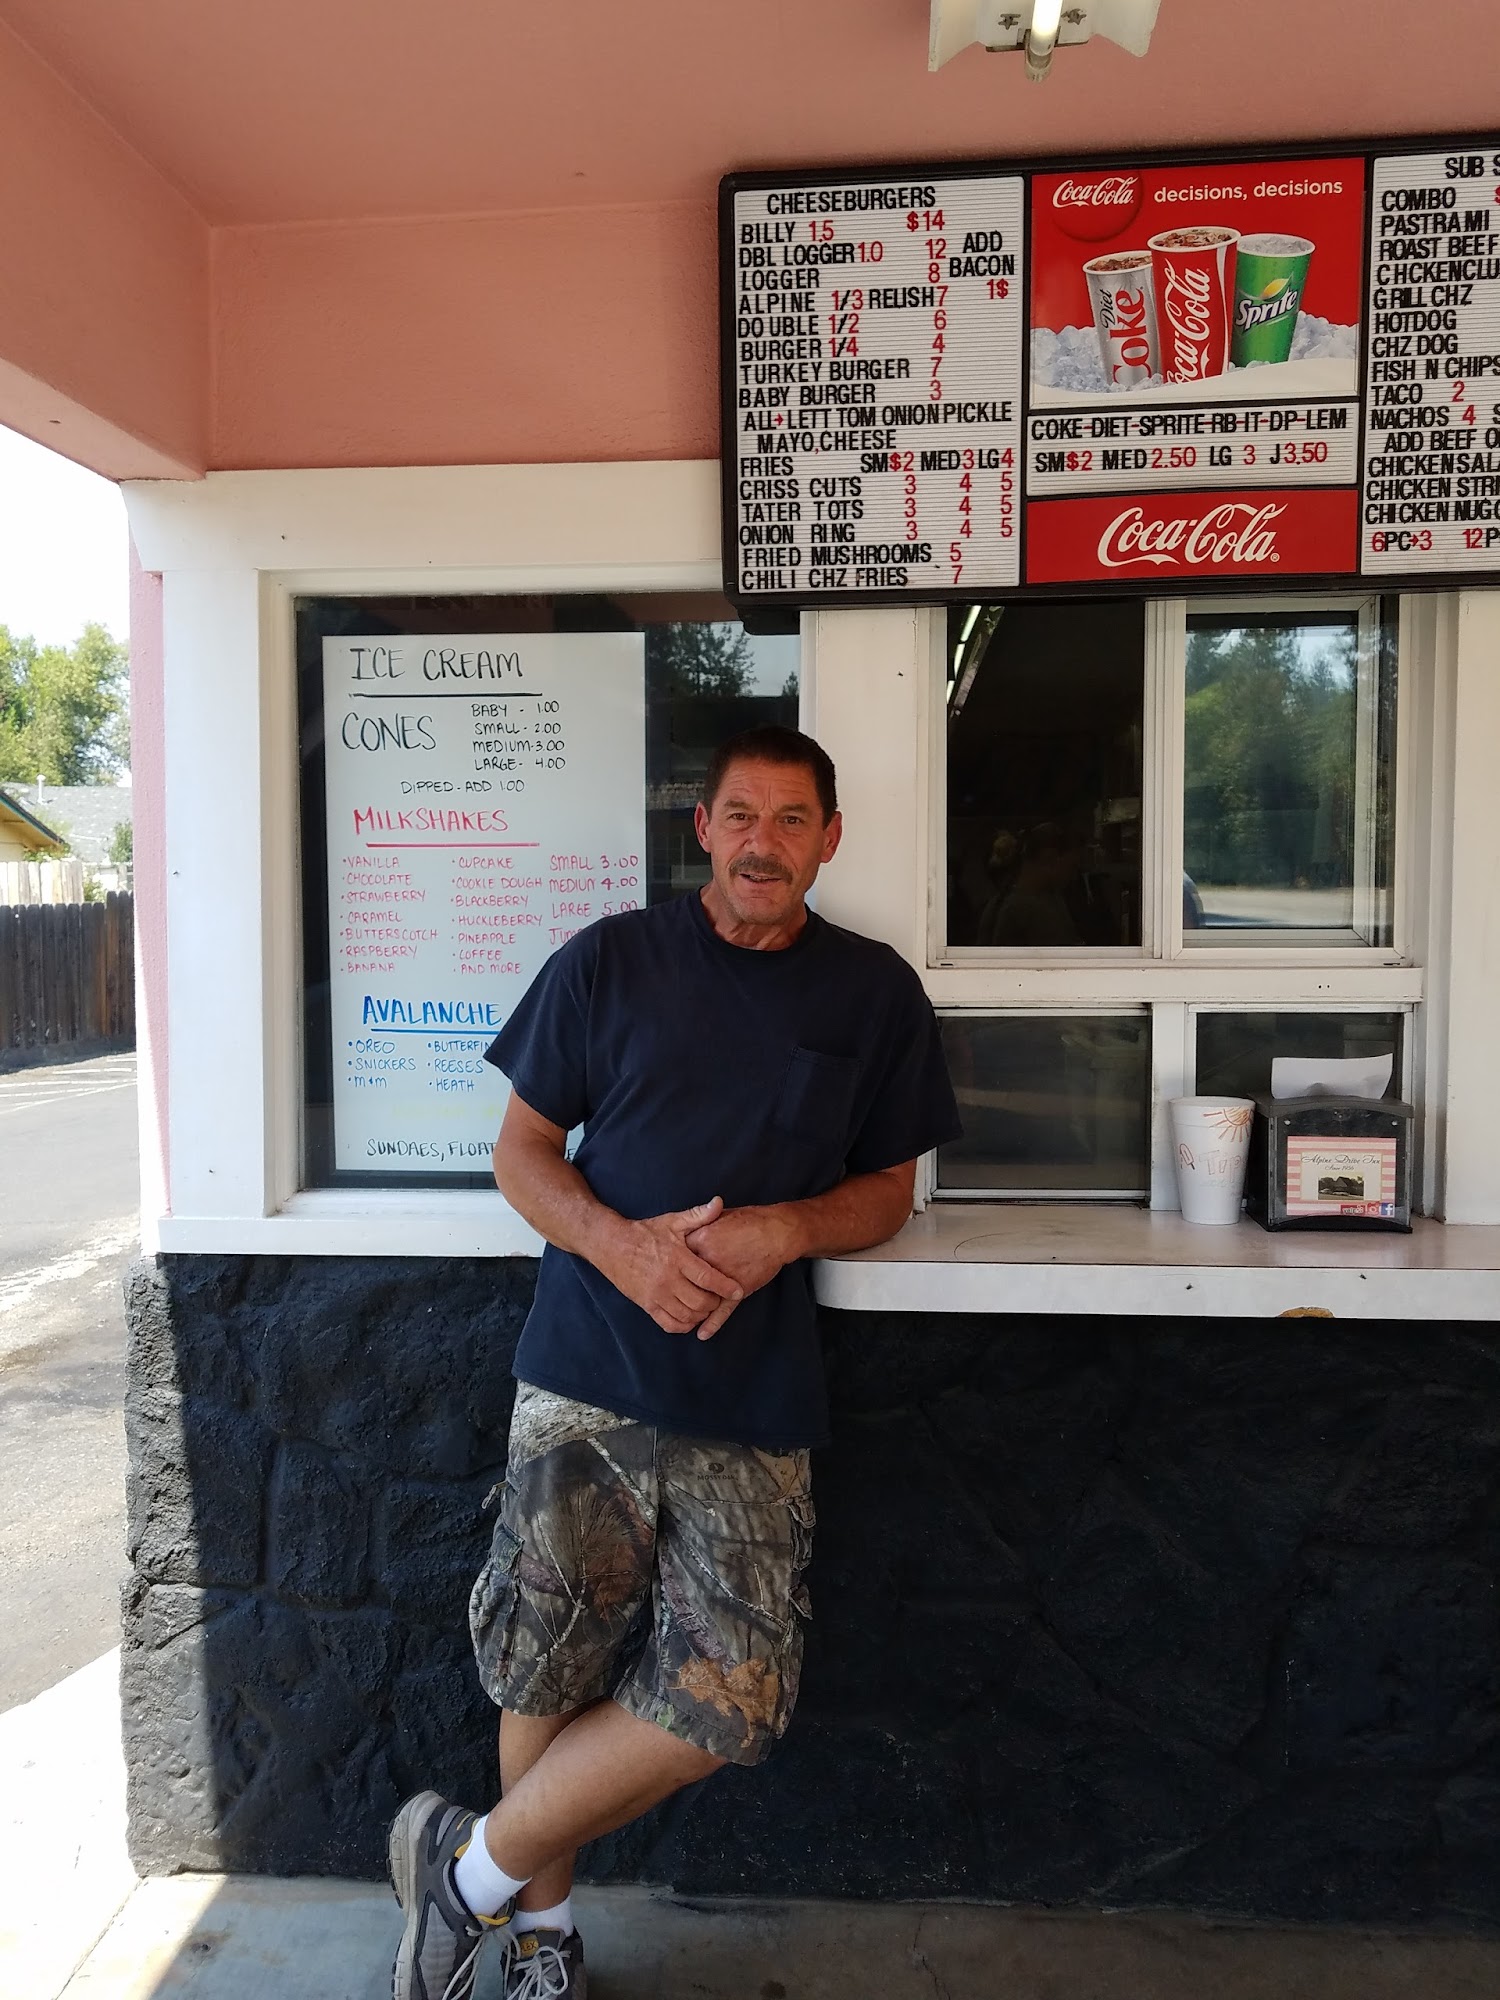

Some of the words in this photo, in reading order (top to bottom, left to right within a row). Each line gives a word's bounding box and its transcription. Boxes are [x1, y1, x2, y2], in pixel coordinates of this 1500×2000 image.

[1445, 156, 1484, 179] SUB
[767, 186, 936, 215] CHEESEBURGERS
[1052, 177, 1138, 209] Coca-Cola
[1154, 184, 1248, 203] decisions,
[1253, 179, 1342, 198] decisions
[1382, 187, 1456, 211] COMBO
[741, 222, 795, 244] BILLY
[809, 220, 834, 242] 1.5
[906, 210, 945, 232] $14
[1381, 210, 1489, 236] PASTRAMI
[740, 246, 776, 267] DBL
[784, 242, 854, 265] LOGGER
[858, 241, 883, 263] 1.0
[925, 239, 946, 260] 12
[963, 230, 1002, 254] ADD
[1380, 237, 1441, 261] ROAST
[1449, 234, 1499, 257] BEEF
[741, 268, 820, 291] LOGGER
[928, 264, 940, 283] 8
[949, 255, 1014, 278] BACON
[739, 292, 815, 314] ALPINE
[831, 289, 864, 310] 1/3
[869, 287, 934, 309] RELISH
[987, 279, 1009, 300] 1$
[1374, 286, 1427, 309] GRILL
[1431, 284, 1473, 307] CHZ
[1100, 289, 1115, 328] Diet
[1236, 284, 1298, 331] Sprite
[828, 313, 860, 334] 1/2
[934, 310, 946, 330] 6
[1375, 309, 1457, 334] HOTDOG
[741, 339, 822, 362] BURGER
[828, 337, 859, 358] 1/4
[932, 334, 945, 353] 4
[1372, 335, 1412, 358] CHZ
[1417, 333, 1458, 355] DOG
[740, 362, 823, 385] TURKEY
[830, 359, 910, 381] BURGER
[931, 357, 942, 377] 7
[1372, 360, 1415, 382] FISH
[1426, 358, 1438, 380] N
[739, 387, 789, 408] BABY
[800, 384, 875, 406] BURGER
[930, 381, 942, 400] 3
[1371, 383, 1423, 406] TACO
[1452, 380, 1465, 402] 2
[788, 408, 832, 429] LETT
[837, 407, 875, 427] TOM
[882, 403, 939, 425] ONION
[944, 402, 1012, 423] PICKLE
[1371, 406, 1449, 430] NACHOS
[1462, 405, 1475, 425] 4
[1384, 431, 1423, 453] ADD
[1430, 429, 1477, 451] BEEF
[740, 456, 793, 477] FRIES
[1210, 445, 1232, 467] LG
[1243, 444, 1256, 465] 3
[1368, 453, 1453, 477] CHICKEN
[740, 480, 799, 500] CRISS
[810, 477, 861, 498] CUTS
[905, 474, 916, 494] 3
[960, 473, 972, 492] 4
[1001, 471, 1012, 492] 5
[1366, 477, 1450, 501] CHICKEN
[742, 502, 801, 522] TATER
[814, 500, 863, 520] TOTS
[905, 498, 916, 518] 3
[959, 496, 971, 515] 4
[1001, 494, 1012, 515] 5
[1365, 501, 1449, 525] CHICKEN
[740, 525, 794, 545] ONION
[811, 523, 855, 543] RING
[906, 521, 918, 540] 3
[960, 519, 972, 538] 4
[1001, 517, 1012, 538] 5
[1097, 503, 1288, 567] Coca-Cola
[1419, 530, 1432, 551] 3
[744, 547, 801, 568] FRIED
[811, 543, 931, 566] MUSHROOMS
[950, 542, 961, 562] 5
[742, 570, 796, 590] CHILI
[809, 568, 847, 588] CHZ
[856, 567, 908, 587] FRIES
[952, 565, 963, 584] 7
[350, 646, 405, 680] ICE
[423, 648, 523, 681] CREAM
[472, 704, 508, 717] BABY
[537, 700, 560, 713] 1.00
[342, 712, 437, 751] CONES
[534, 722, 562, 734] 2.00
[536, 757, 566, 770] 4.00
[500, 779, 525, 792] 1.00
[354, 806, 508, 835] MILKSHAKES
[348, 856, 399, 868] VANILLA
[459, 857, 514, 868] CUPCAKE
[550, 855, 593, 871] SMALL
[600, 855, 639, 869] 3.00
[346, 872, 412, 886] CHOCOLATE
[456, 878, 494, 889] COOKIE
[501, 878, 542, 888] DOUGH
[601, 876, 638, 890] 4.00
[346, 890, 426, 904] STRAWBERRY
[456, 895, 528, 907] BLACKBERRY
[348, 911, 403, 924] CARAMEL
[459, 914, 543, 926] HUCKLEBERRY
[552, 902, 592, 919] LARGE
[345, 928, 438, 941] BUTTERSCOTCH
[458, 932, 516, 944] PINEAPPLE
[346, 945, 417, 958] RASPBERRY
[459, 949, 503, 960] COFFEE
[348, 962, 395, 974] BANANA
[461, 964, 485, 975] AND
[490, 963, 521, 974] MORE
[363, 995, 502, 1026] AVALANCHE
[356, 1040, 395, 1054] OREO
[355, 1058, 416, 1071] SNICKERS
[434, 1059, 484, 1074] REESES
[436, 1080, 474, 1092] HEATH
[367, 1138, 445, 1162] SUNDAES,
